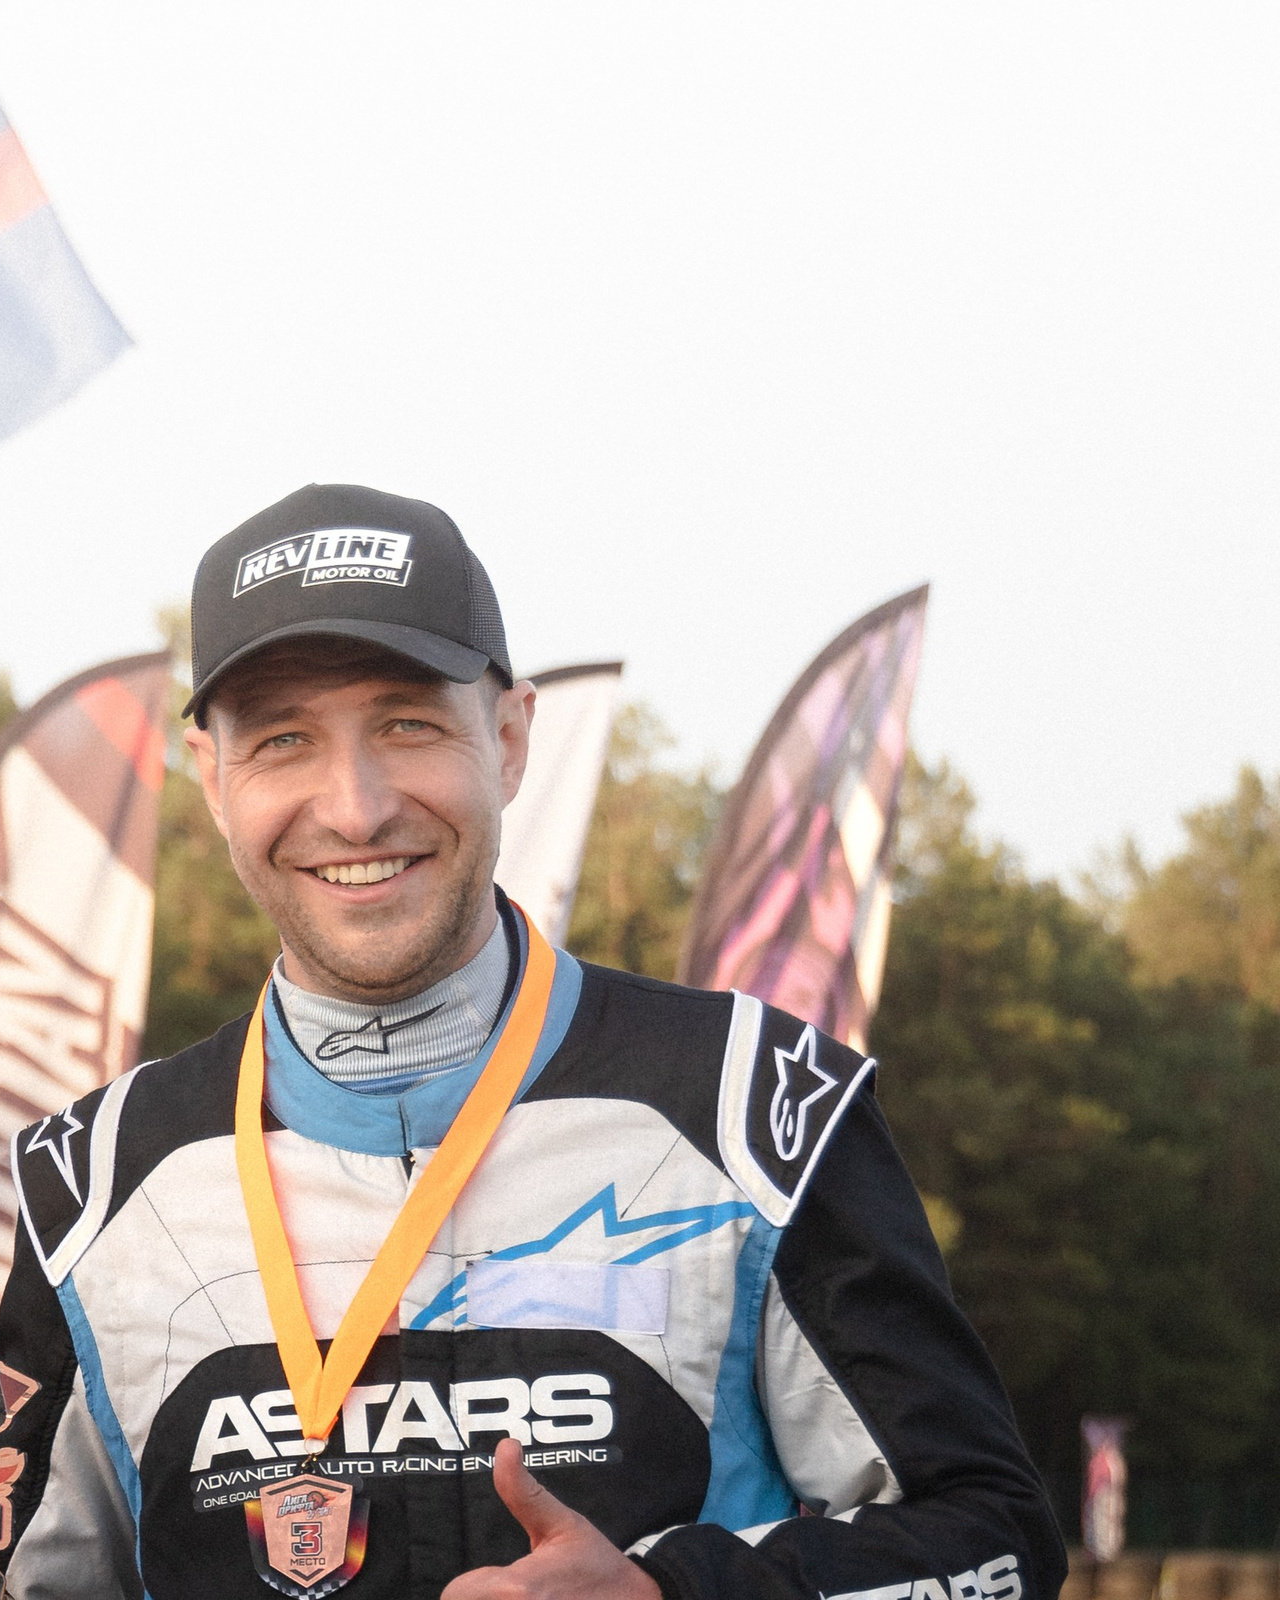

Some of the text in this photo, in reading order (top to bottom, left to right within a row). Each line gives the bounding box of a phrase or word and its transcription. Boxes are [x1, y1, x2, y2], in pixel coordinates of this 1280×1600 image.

[311, 566, 399, 582] MOTOR OIL
[190, 1373, 614, 1473] ASTARS
[461, 1448, 608, 1471] ENNEERING
[202, 1490, 261, 1509] ONE GOAL
[291, 1521, 322, 1556] 3
[290, 1557, 326, 1567] МЕСТО
